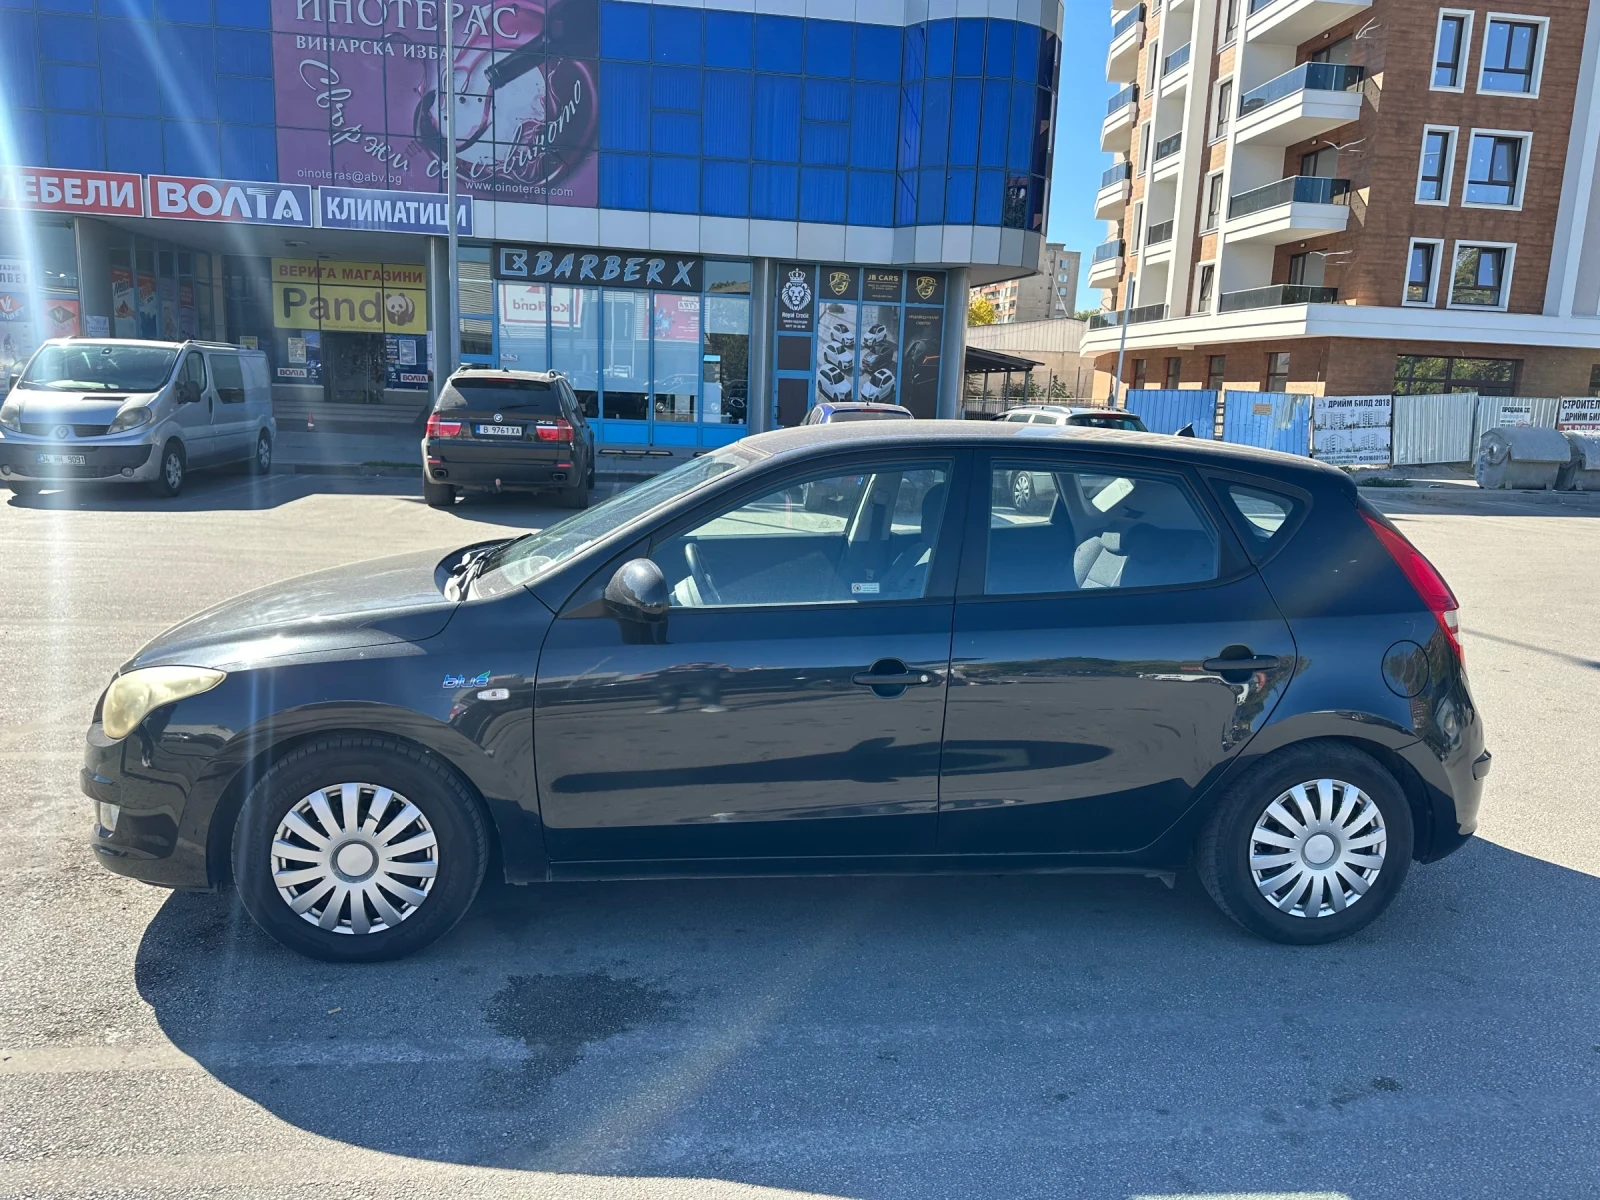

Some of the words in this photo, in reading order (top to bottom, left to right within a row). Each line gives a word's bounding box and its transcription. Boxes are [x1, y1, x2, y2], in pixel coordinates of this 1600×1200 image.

[296, 35, 395, 56] ВИНАРСКА
[297, 167, 402, 185] oinoteras@abv.bg
[465, 181, 574, 197] www.oinoteras.com
[157, 181, 304, 221] ВОЛТА
[327, 196, 467, 231] КЛИМАТИЦИ
[279, 264, 337, 279] ВЕРИГА
[342, 268, 423, 283] МАГАЗИНИ
[532, 250, 666, 285] BARBER
[671, 260, 696, 287] X
[402, 374, 427, 382] ВОЛТА
[1328, 398, 1353, 408] ДРИЙМ
[1354, 399, 1373, 408] БИЛД
[1374, 398, 1391, 407] 2018
[1562, 399, 1600, 410] СТРОИТЕЛ
[483, 426, 489, 434] B
[491, 426, 510, 434] 9761
[510, 427, 521, 435] XA
[443, 671, 490, 688] blue
